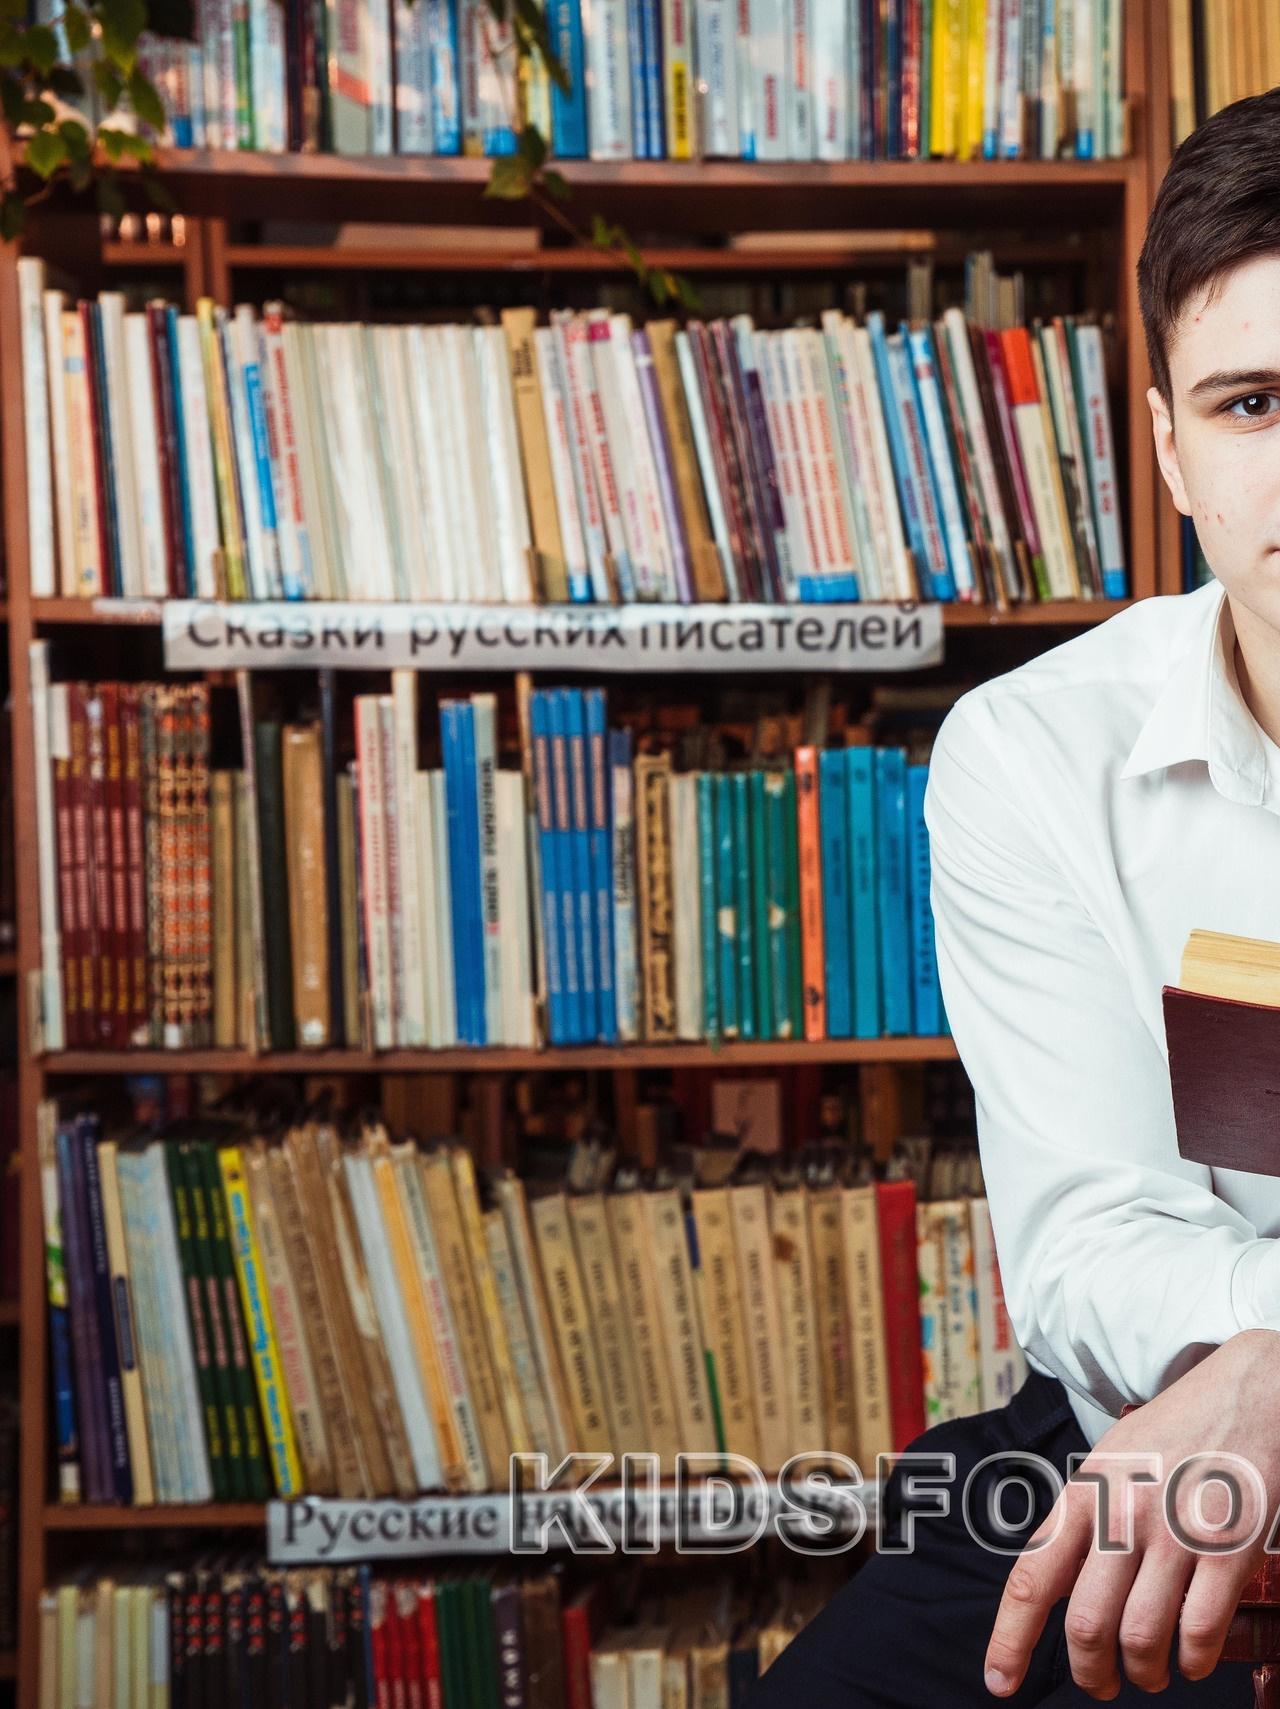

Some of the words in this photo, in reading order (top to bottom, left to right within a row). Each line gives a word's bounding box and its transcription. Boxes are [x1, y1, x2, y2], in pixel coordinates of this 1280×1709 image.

[188, 602, 385, 648] Сказки
[409, 606, 627, 656] русских
[639, 594, 923, 652] писателей
[285, 1500, 498, 1556] Русские
